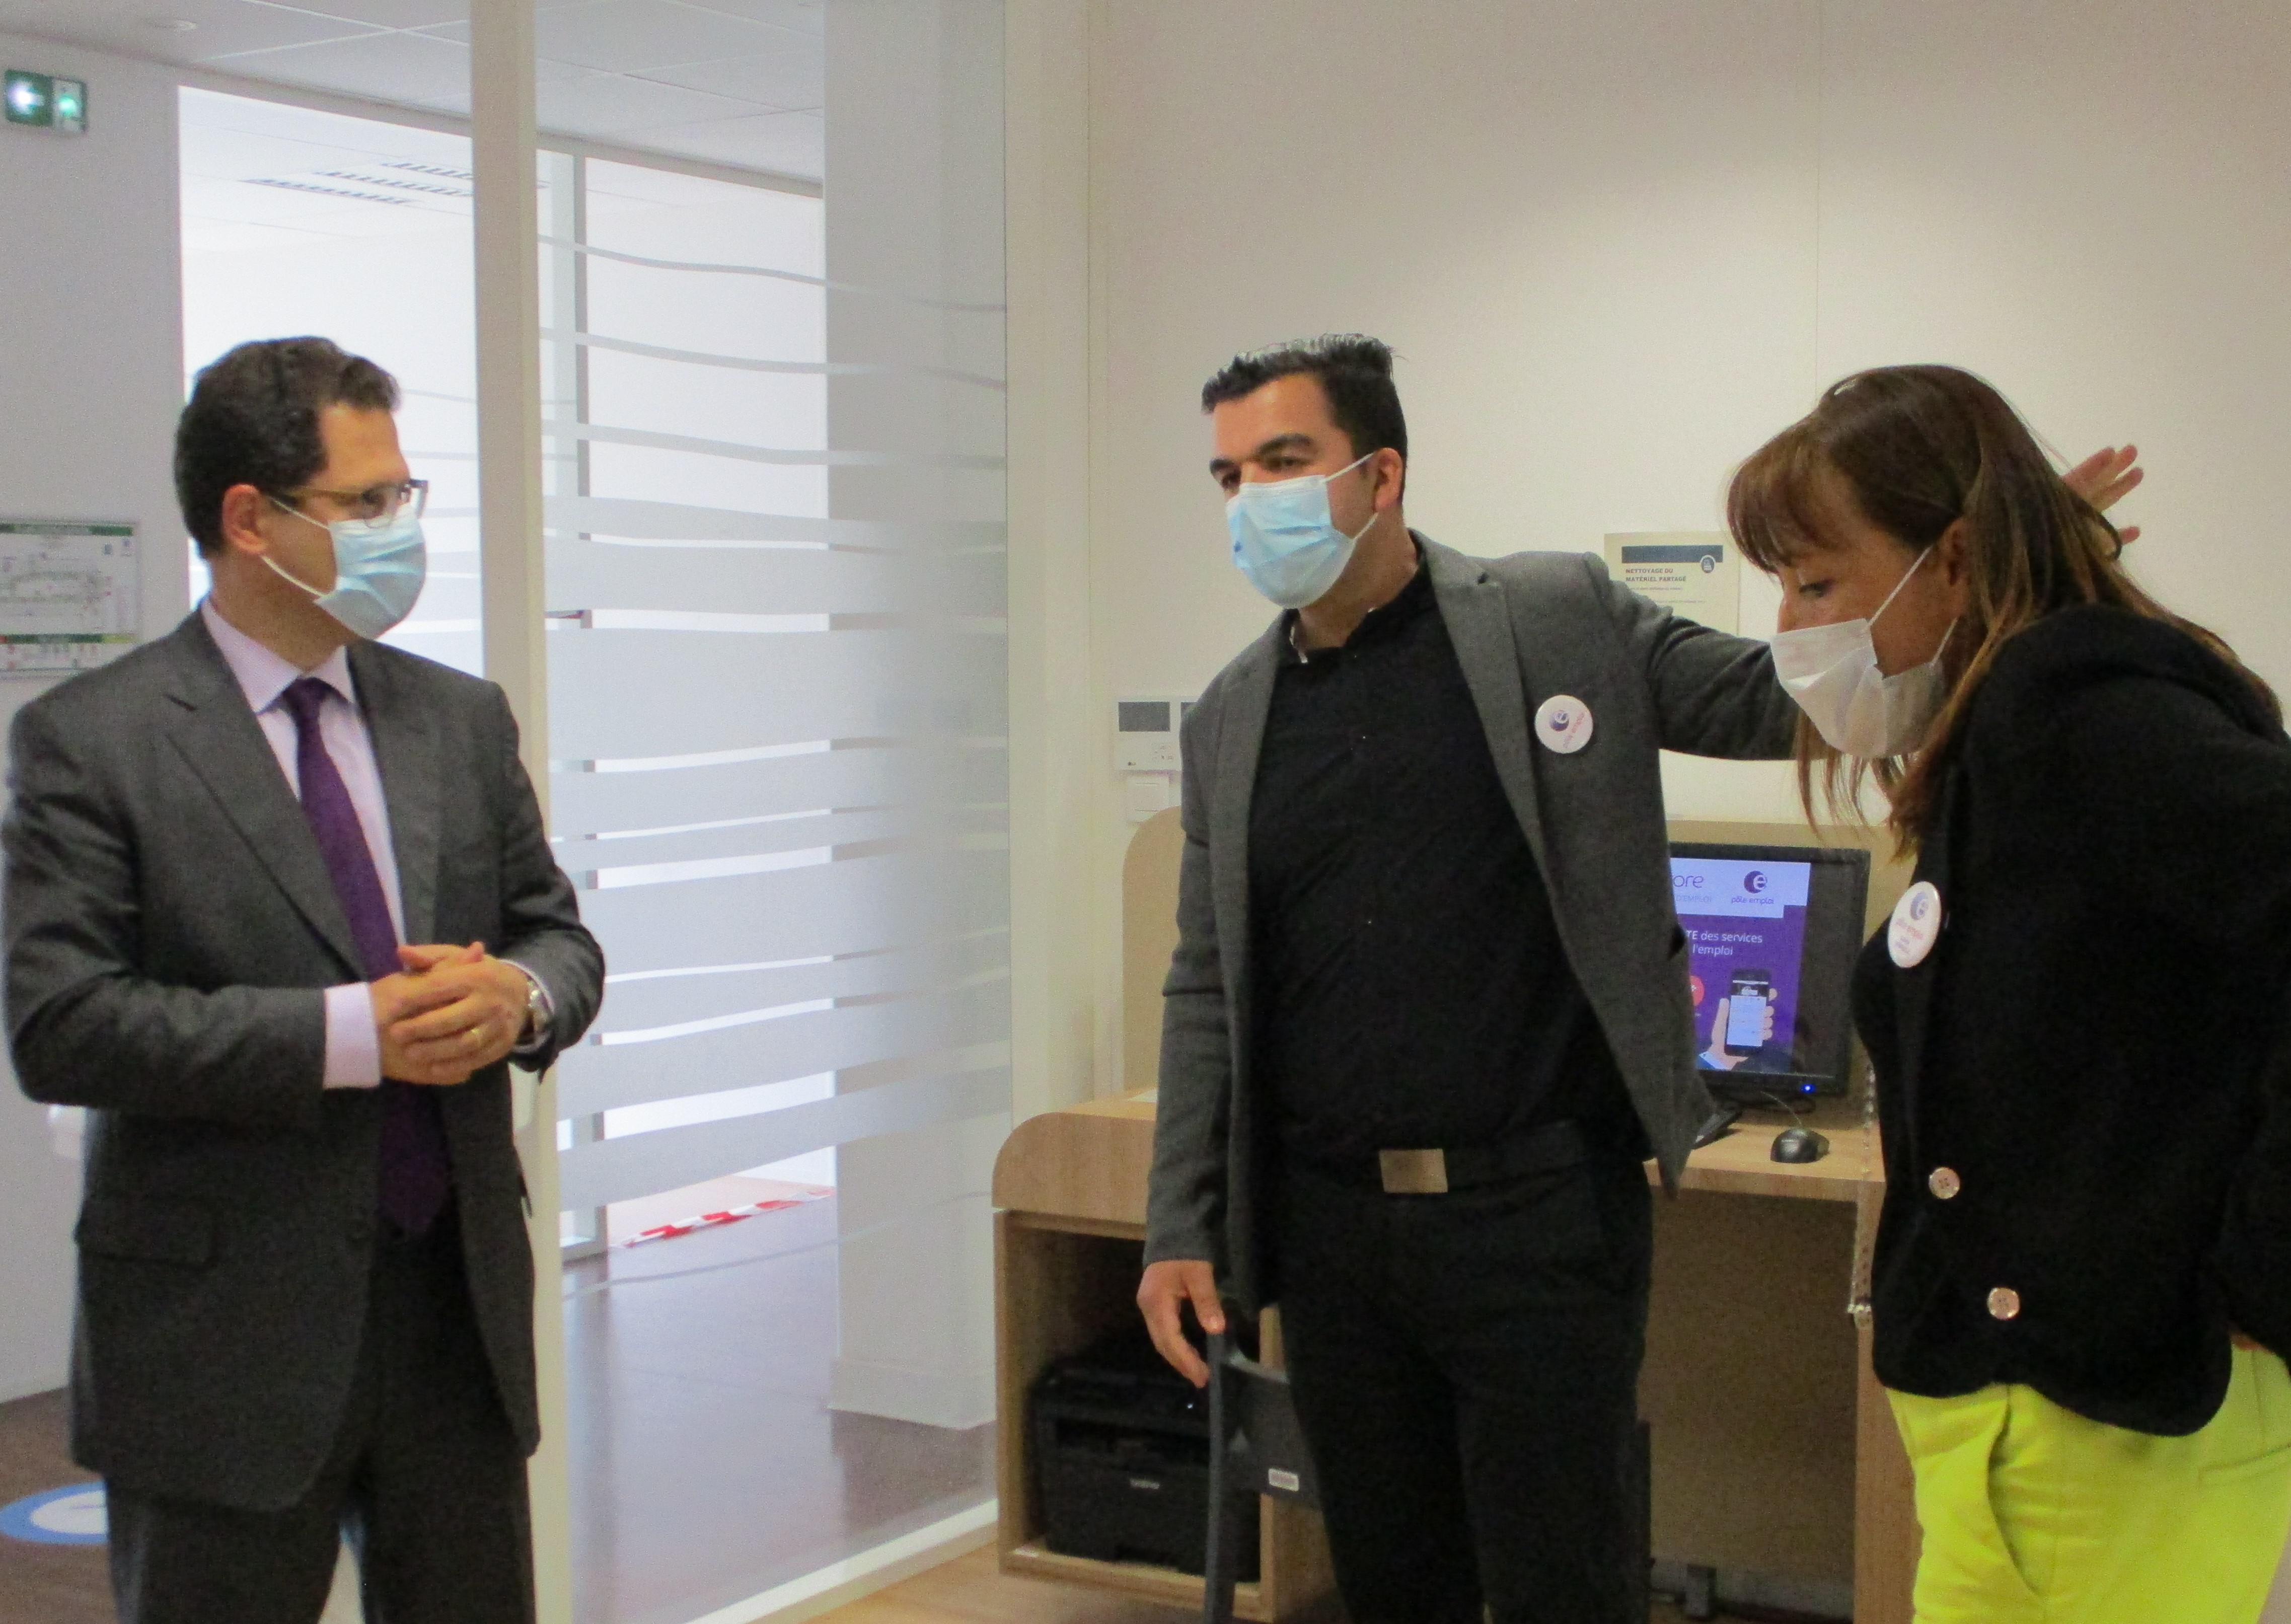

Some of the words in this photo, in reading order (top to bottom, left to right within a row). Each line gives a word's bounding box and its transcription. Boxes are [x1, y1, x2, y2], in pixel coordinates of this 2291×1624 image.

[1673, 875, 1704, 888] ore
[1732, 896, 1747, 904] pôle
[1749, 897, 1774, 906] emploi
[1686, 930, 1698, 940] TE
[1701, 931, 1719, 940] des
[1722, 933, 1762, 943] services
[1692, 944, 1733, 956] l'emploi
